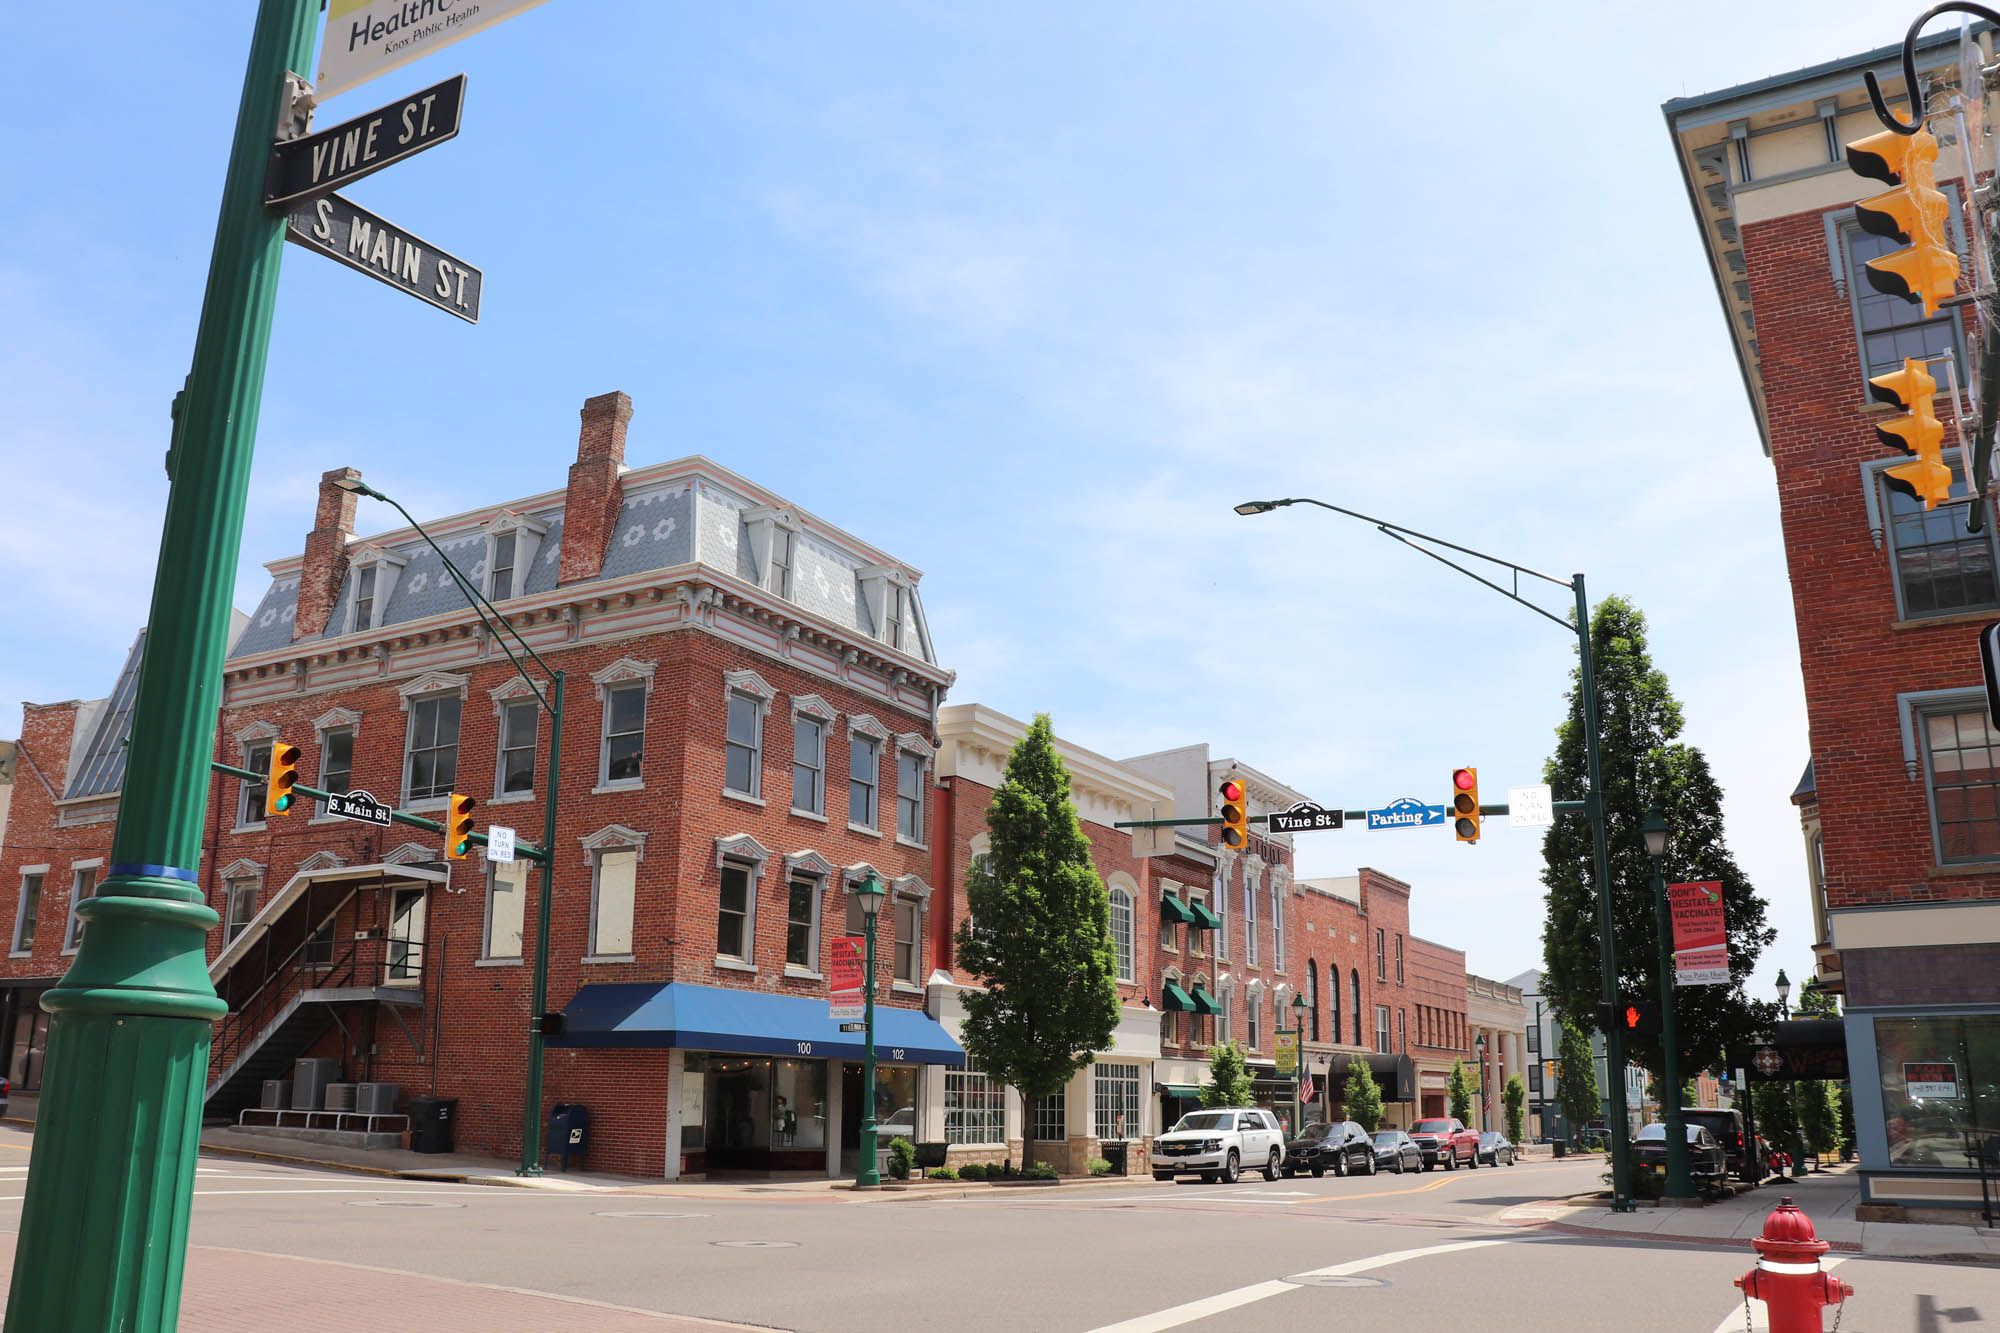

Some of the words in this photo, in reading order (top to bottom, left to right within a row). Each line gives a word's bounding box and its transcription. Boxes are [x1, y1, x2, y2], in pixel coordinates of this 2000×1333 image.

[384, 38, 409, 55] Knox
[413, 22, 443, 42] Public
[446, 5, 480, 28] Health
[312, 118, 383, 183] VINE
[398, 94, 437, 145] ST.
[313, 199, 336, 244] S.
[349, 216, 421, 286] MAIN
[435, 260, 469, 309] ST.
[330, 798, 341, 811] S.
[343, 801, 372, 818] Main
[375, 808, 390, 822] St.
[1277, 816, 1312, 829] Vine
[1315, 814, 1336, 827] St.
[1371, 811, 1424, 826] Parking
[496, 831, 507, 840] NO
[494, 839, 510, 849] TURN
[1671, 887, 1696, 898] DON'T
[797, 1042, 812, 1055] 100
[892, 1048, 905, 1060] 102
[1913, 1063, 1947, 1073] FOR
[1907, 1072, 1955, 1082] RENT
